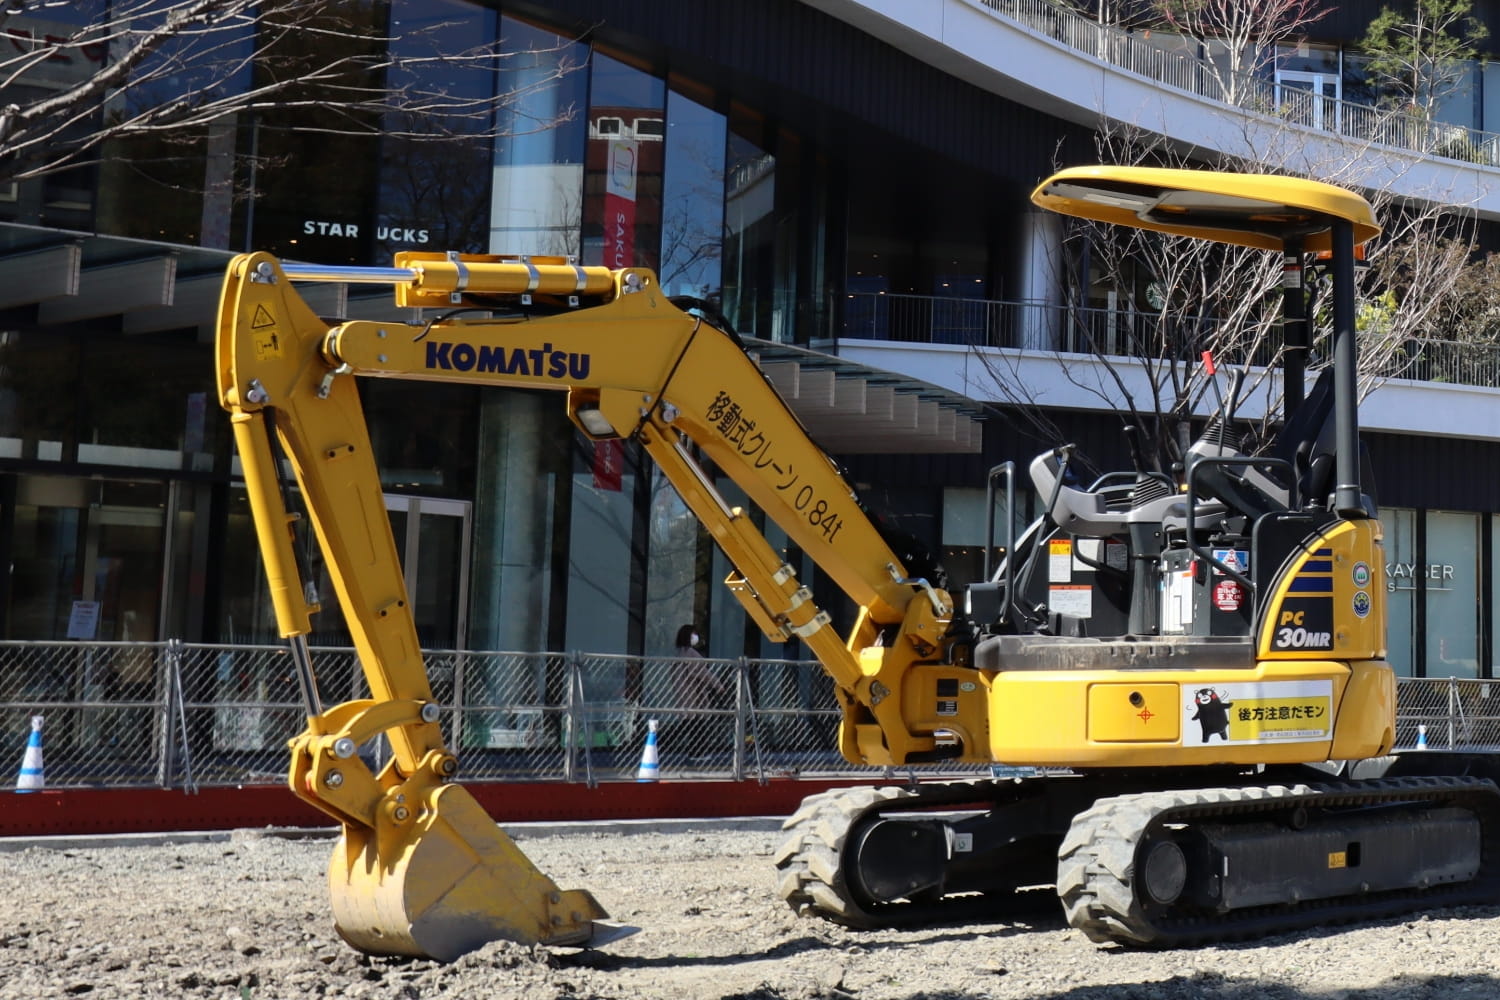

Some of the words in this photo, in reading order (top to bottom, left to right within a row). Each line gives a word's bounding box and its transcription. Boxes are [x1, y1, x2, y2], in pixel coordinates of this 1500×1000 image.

[303, 220, 429, 243] STARUCKS
[425, 341, 590, 380] KOMATSU
[705, 391, 798, 490] 移動式クレーン
[795, 485, 843, 544] 0.84t
[1385, 563, 1454, 579] KAYER
[1280, 611, 1305, 626] PC
[1276, 627, 1331, 647] 30MR
[1238, 705, 1325, 721] 後方注意だモン
